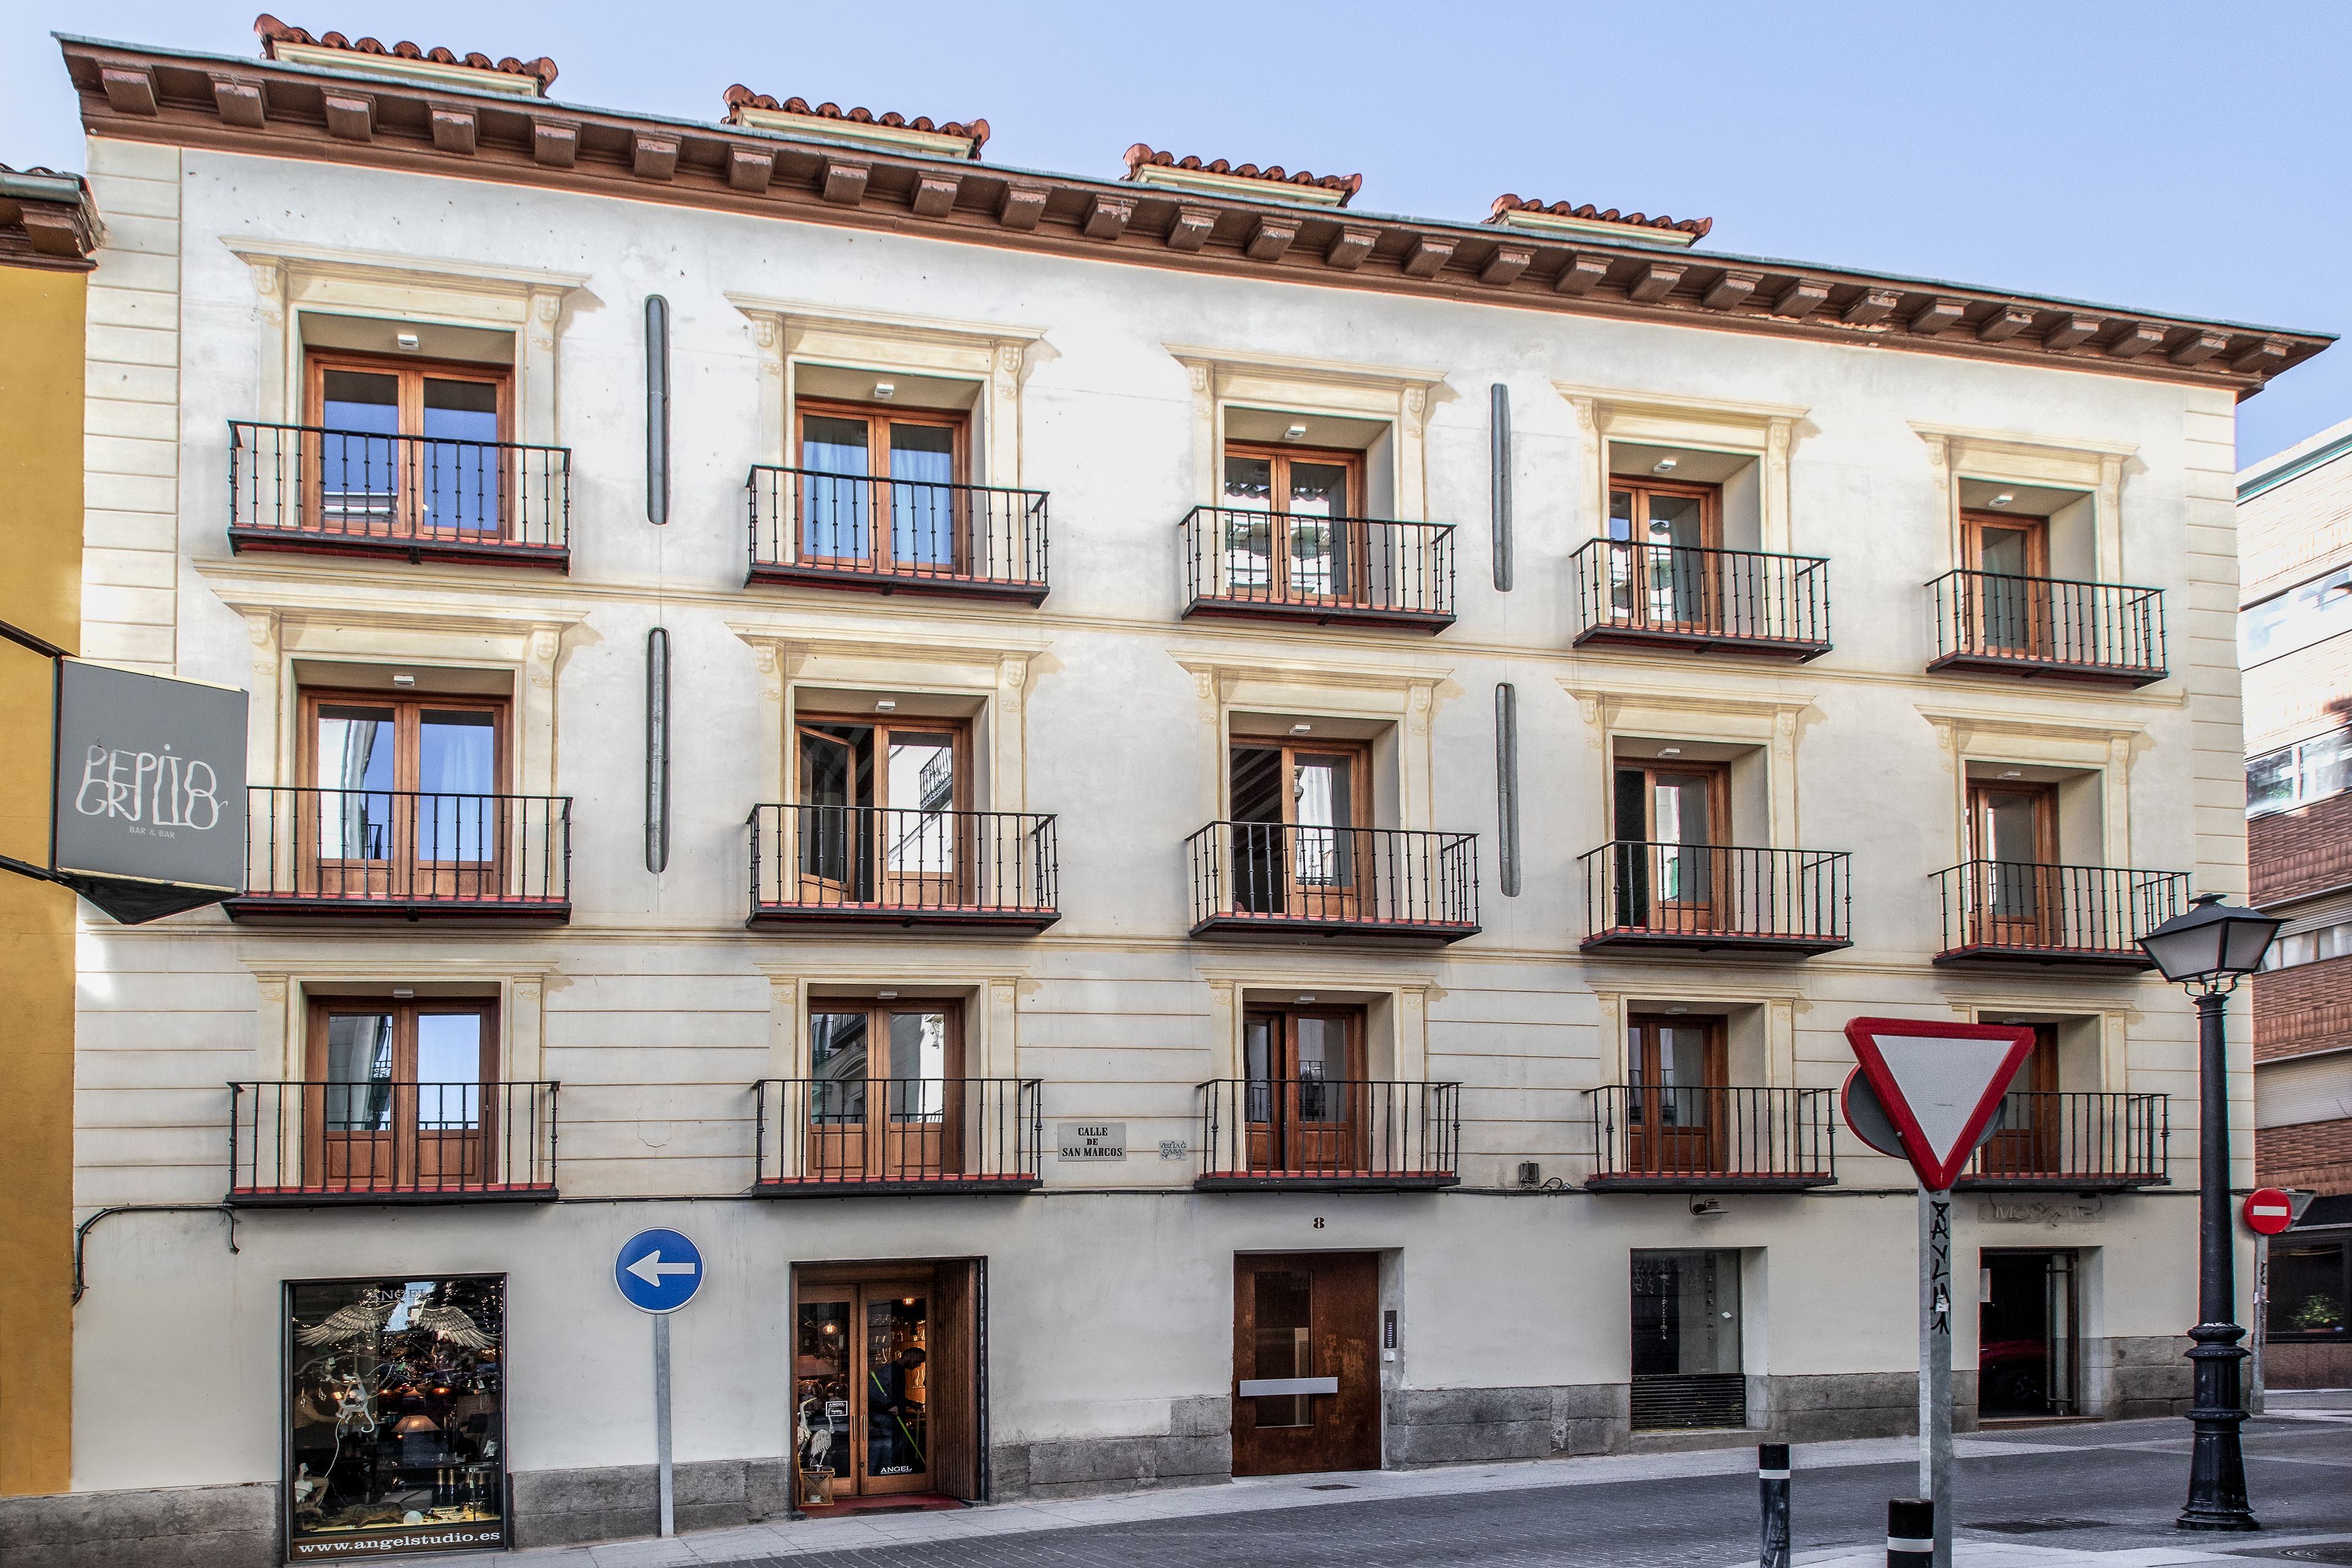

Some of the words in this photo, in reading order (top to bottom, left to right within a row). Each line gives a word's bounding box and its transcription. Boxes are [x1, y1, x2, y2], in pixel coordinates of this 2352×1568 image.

[129, 826, 146, 835] BAR
[159, 829, 176, 839] BAR
[1077, 1127, 1108, 1136] CALLE
[1062, 1147, 1080, 1157] SAN
[1084, 1147, 1123, 1157] MARCOS
[1313, 1217, 1325, 1229] 8
[298, 1532, 500, 1553] www.angelstudio.es
